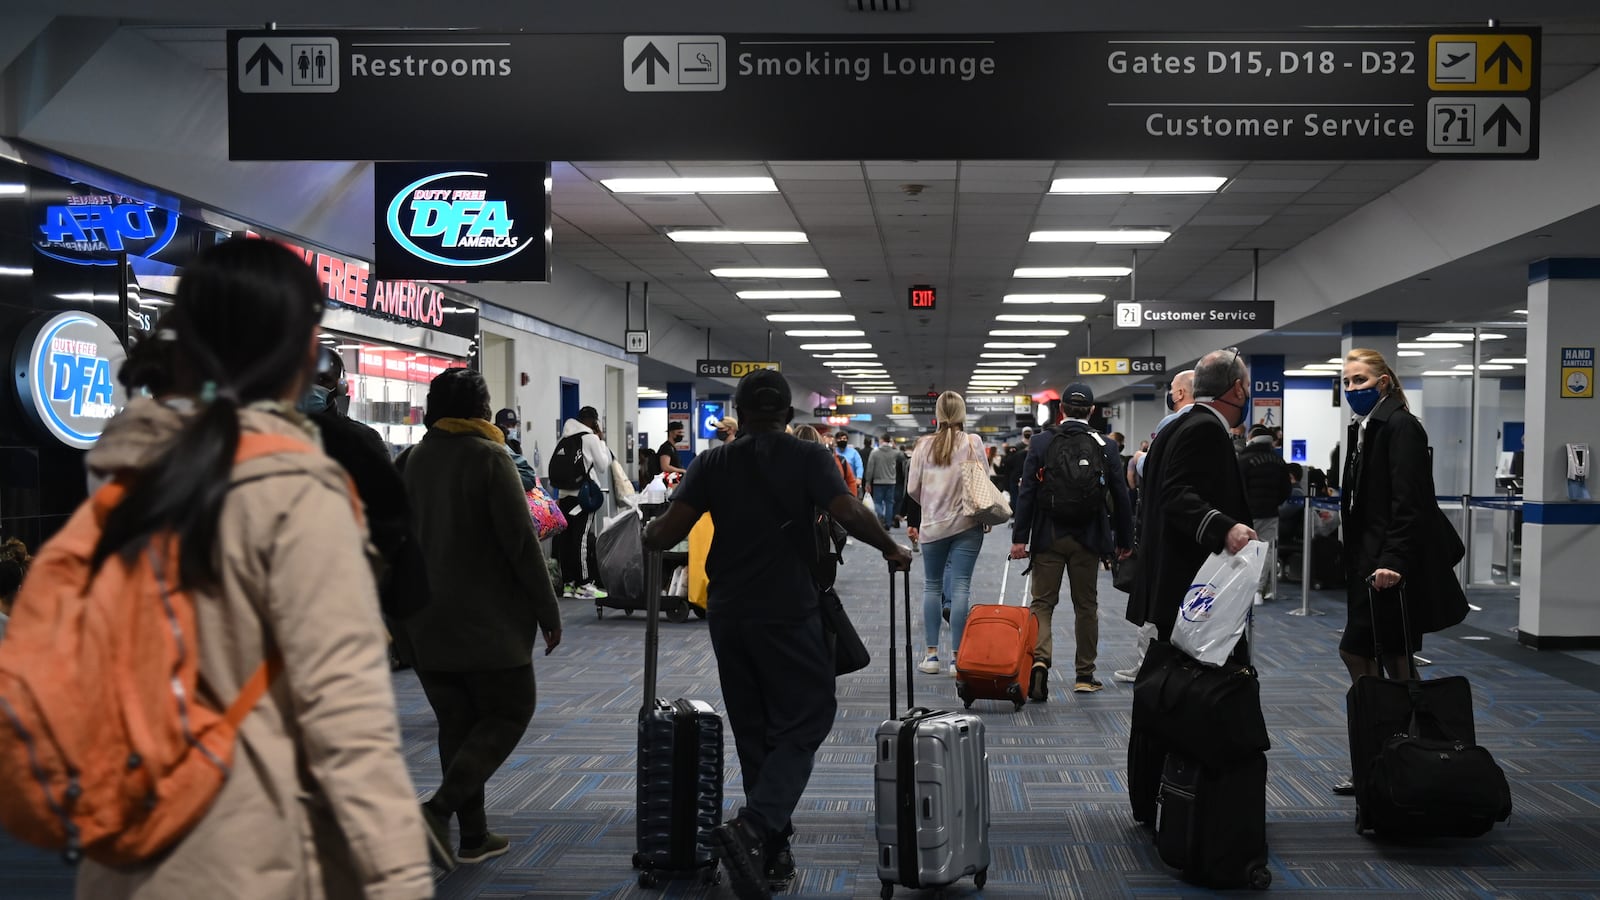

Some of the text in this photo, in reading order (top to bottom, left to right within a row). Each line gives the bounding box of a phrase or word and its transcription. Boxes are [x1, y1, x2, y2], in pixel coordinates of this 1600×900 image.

[351, 53, 512, 77] Restrooms
[738, 51, 996, 81] Smoking Lounge
[1107, 50, 1196, 75] Gates
[1361, 50, 1415, 75] D32
[1145, 112, 1414, 137] Customer Service
[413, 189, 487, 200] DUTY FREE
[410, 200, 514, 248] DFA
[457, 236, 519, 248] AMERICAS
[317, 252, 445, 328] FREE AMERICAS
[912, 290, 933, 307] EXIT
[1143, 309, 1207, 321] Customer
[1209, 309, 1257, 321] Service
[52, 337, 98, 357] DUTY FREE
[1565, 349, 1591, 360] HAND
[699, 363, 729, 374] Gate
[1081, 360, 1163, 373] D15 Gate
[1562, 359, 1593, 367] SANITIZER
[50, 351, 114, 417] DFA
[1254, 380, 1280, 392] D15
[670, 401, 689, 410] D18
